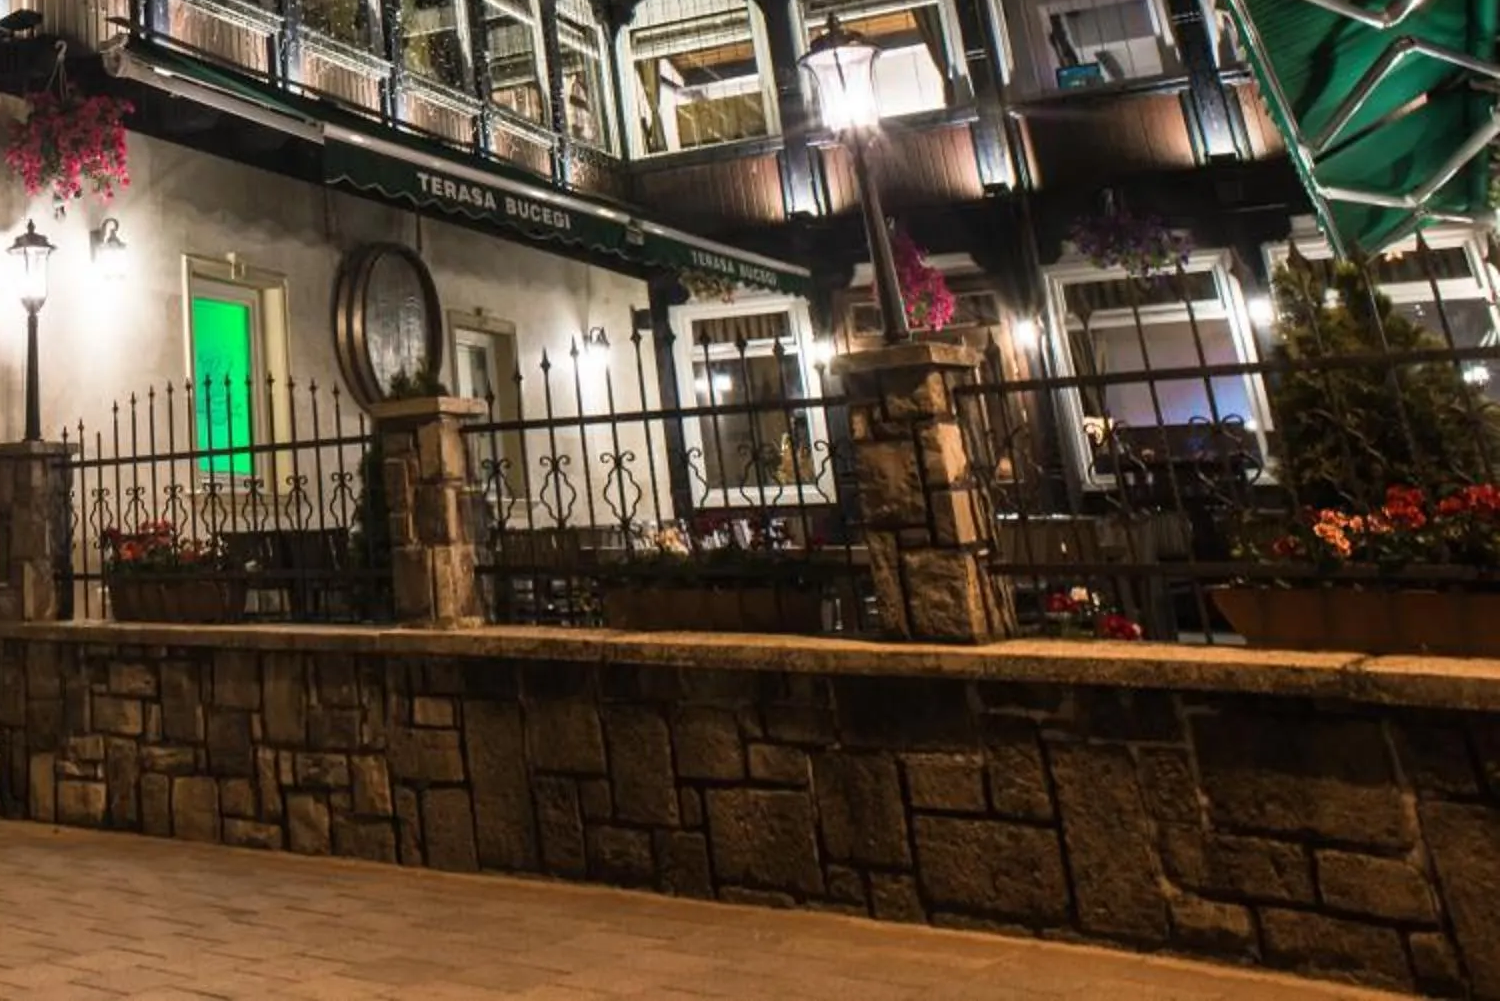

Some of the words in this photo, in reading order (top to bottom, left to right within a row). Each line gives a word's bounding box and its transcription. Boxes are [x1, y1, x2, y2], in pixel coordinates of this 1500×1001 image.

[417, 172, 497, 212] TERASA
[506, 196, 571, 231] BUCEGI
[690, 249, 736, 275] TERASA
[739, 264, 779, 287] BUCEGI
